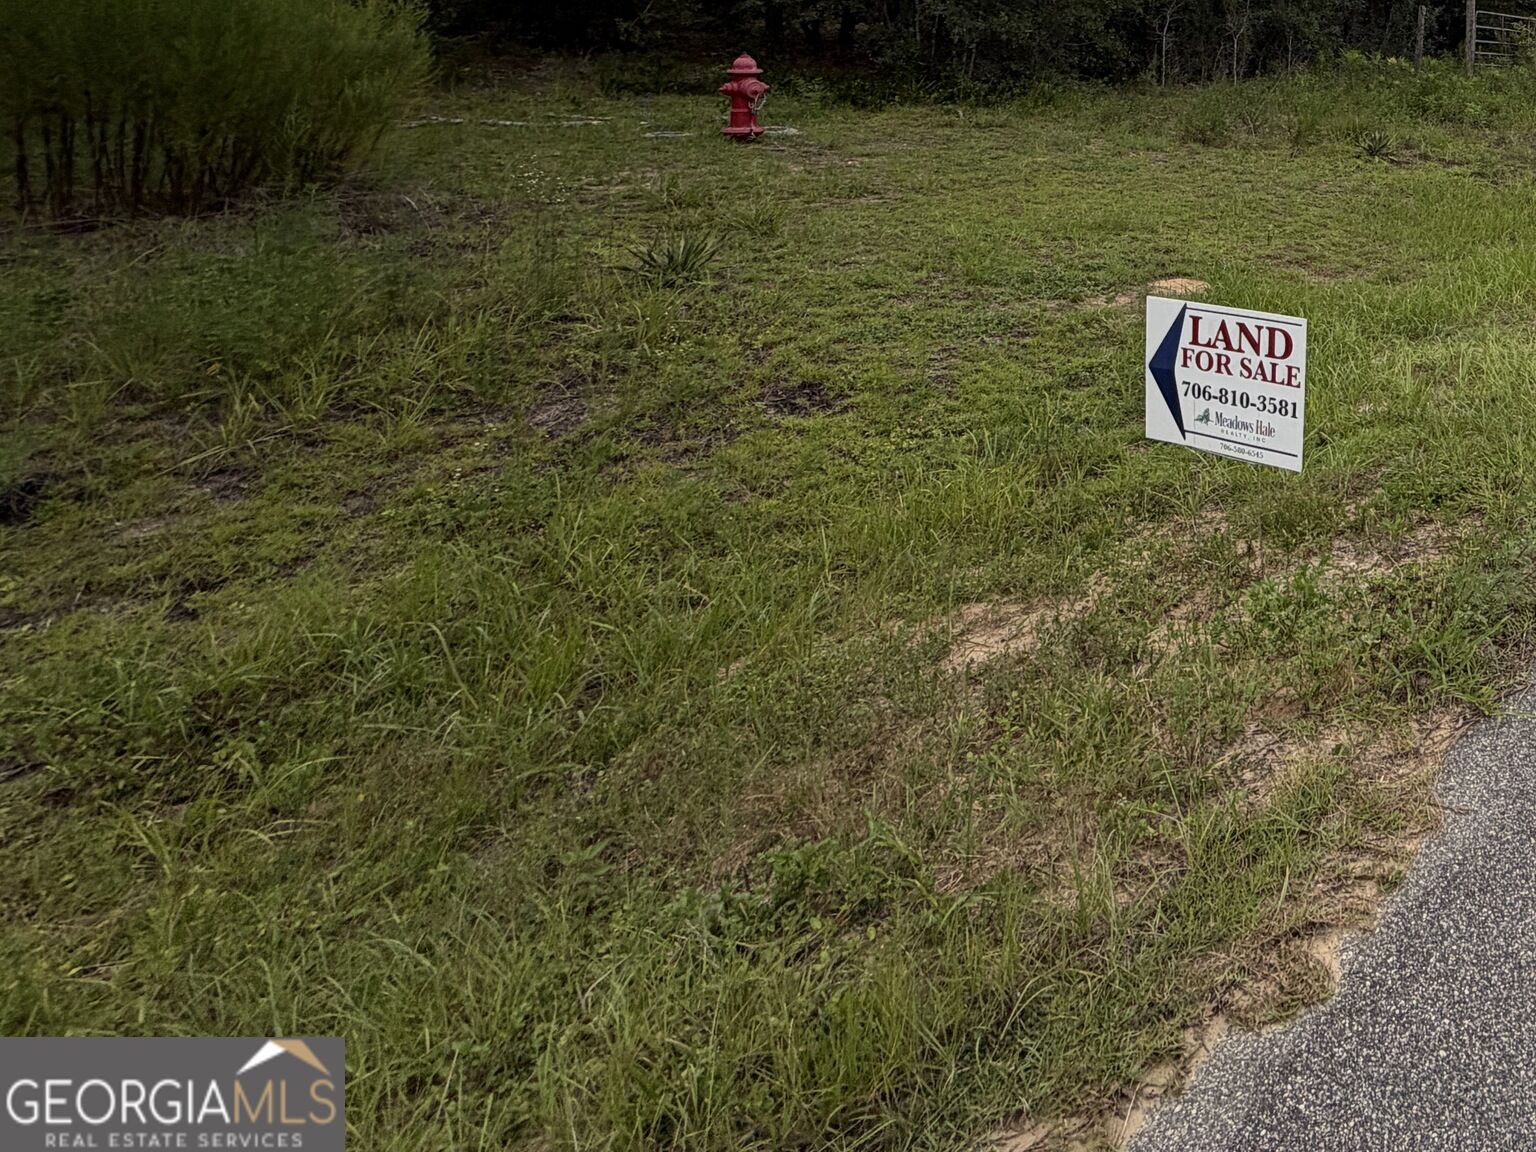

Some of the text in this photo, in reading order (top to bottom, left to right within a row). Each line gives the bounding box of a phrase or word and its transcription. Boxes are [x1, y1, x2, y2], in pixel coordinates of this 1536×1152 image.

[1188, 315, 1293, 360] LAND
[1180, 347, 1301, 389] FOR SALE
[1181, 380, 1298, 419] 706-810-3581
[1214, 411, 1276, 437] Meadows Hale
